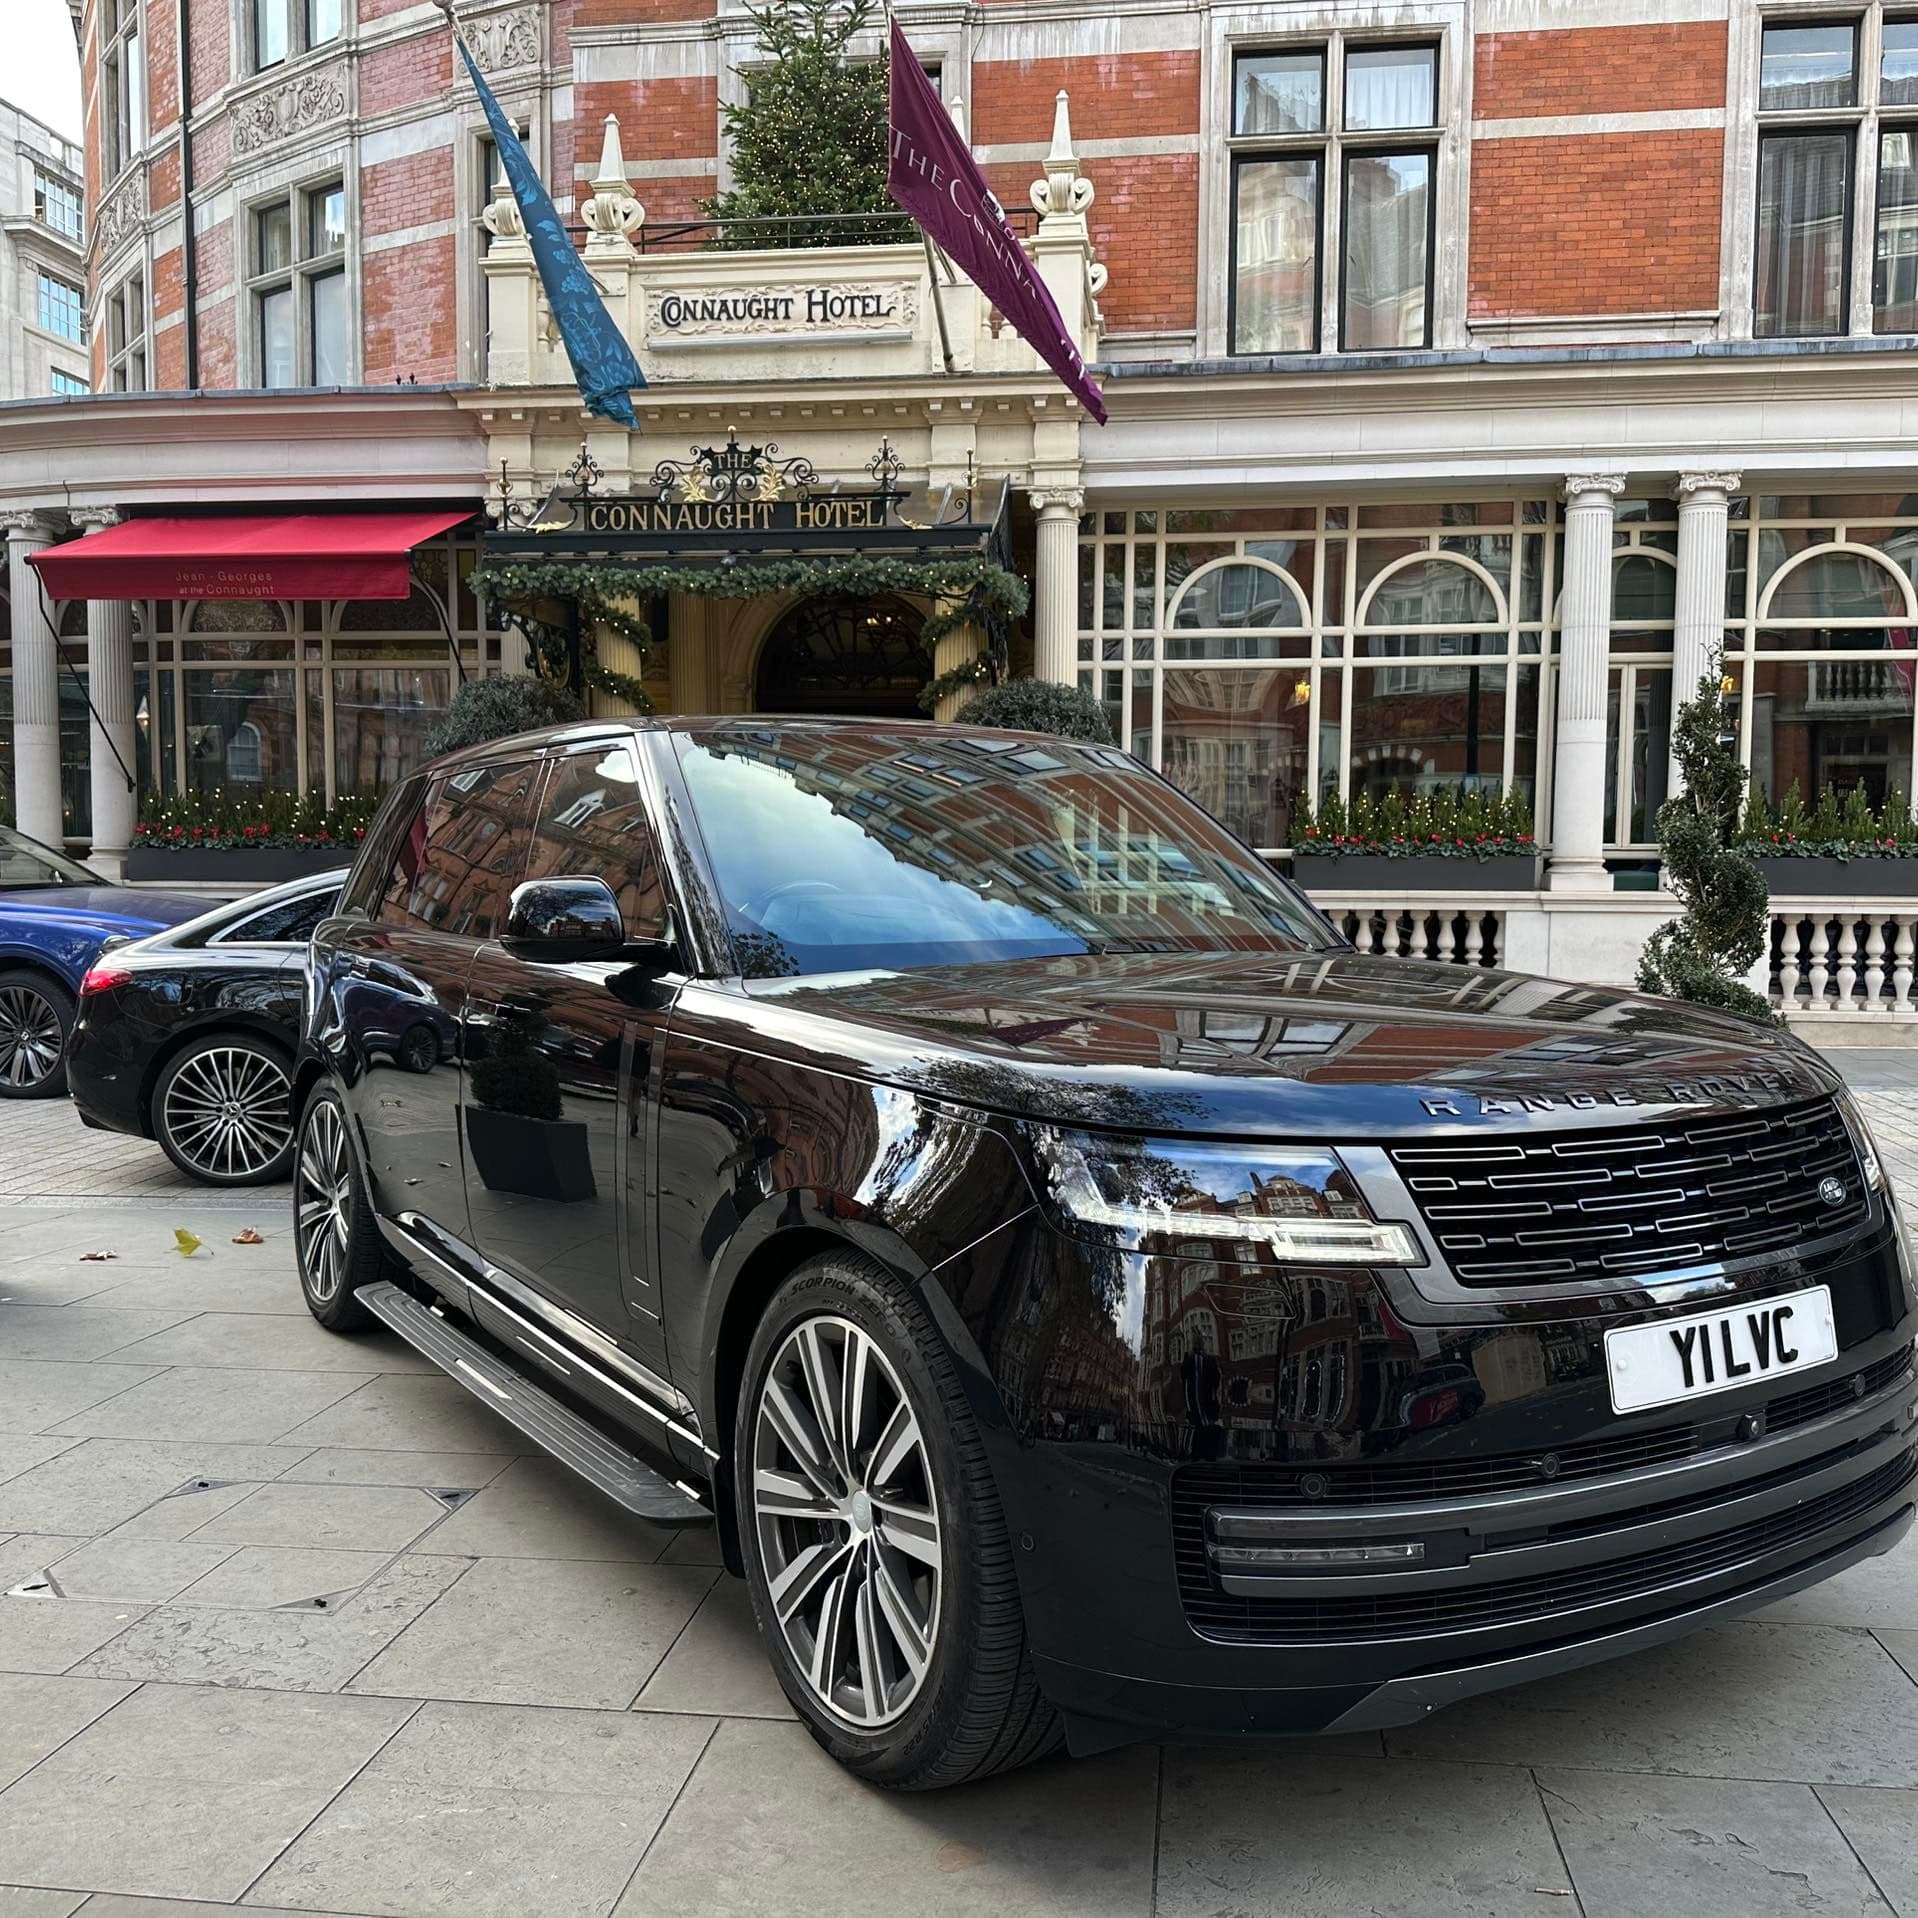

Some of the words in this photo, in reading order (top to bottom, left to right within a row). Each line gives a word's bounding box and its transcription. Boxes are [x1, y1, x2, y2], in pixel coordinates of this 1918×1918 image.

[889, 125, 943, 191] THE
[660, 295, 795, 328] CONNAUGHT
[805, 289, 897, 323] HOTEL
[714, 453, 752, 470] THE
[590, 503, 775, 532] CONNAUGHT
[795, 500, 884, 529] HOTEL
[217, 570, 273, 584] Georges
[206, 584, 275, 597] Connaught
[1419, 1087, 1638, 1117] RANGE
[1664, 1067, 1803, 1102] ROVER
[791, 1276, 857, 1297] SCORPION
